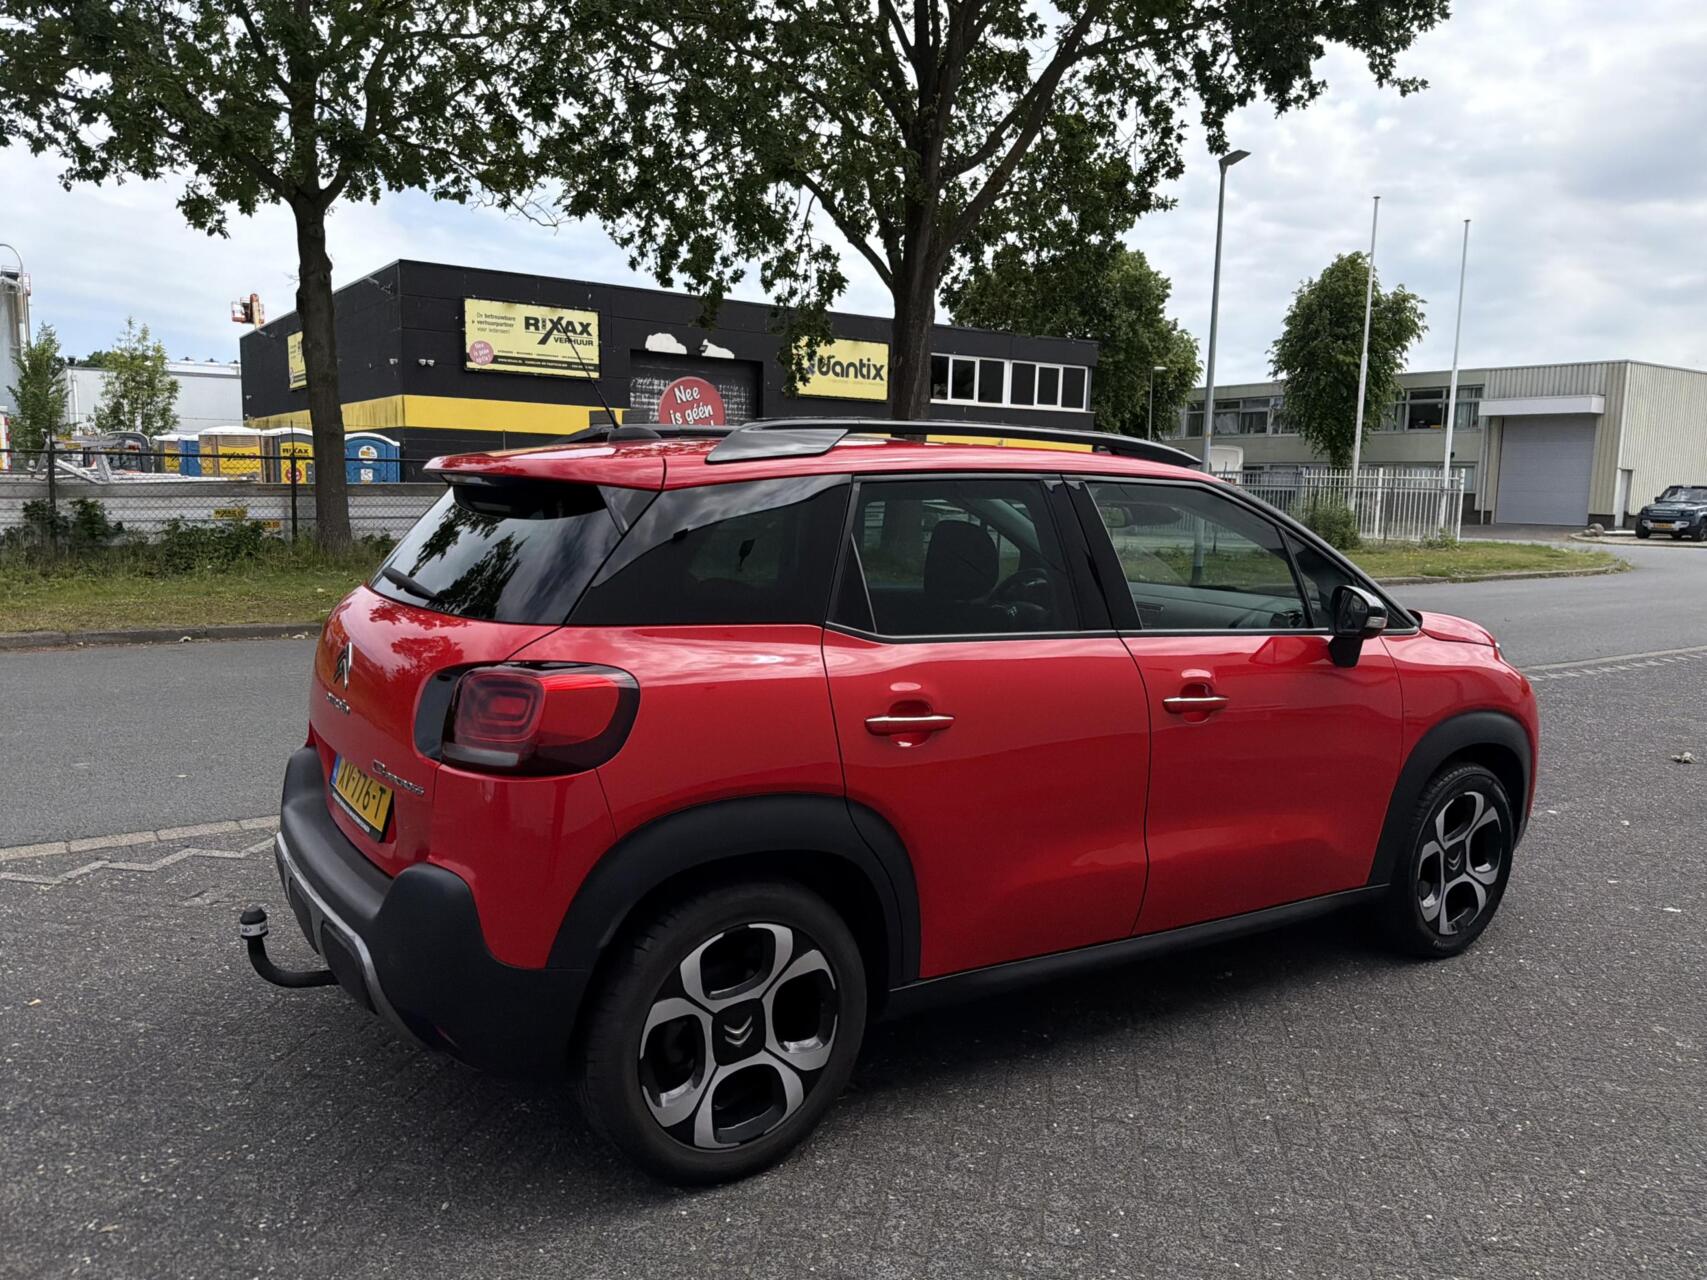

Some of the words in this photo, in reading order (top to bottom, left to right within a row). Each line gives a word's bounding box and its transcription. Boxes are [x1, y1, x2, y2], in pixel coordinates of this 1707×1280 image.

[554, 336, 594, 346] VERHUUR
[674, 385, 700, 404] Nee
[670, 409, 682, 425] is
[685, 402, 714, 424] géén
